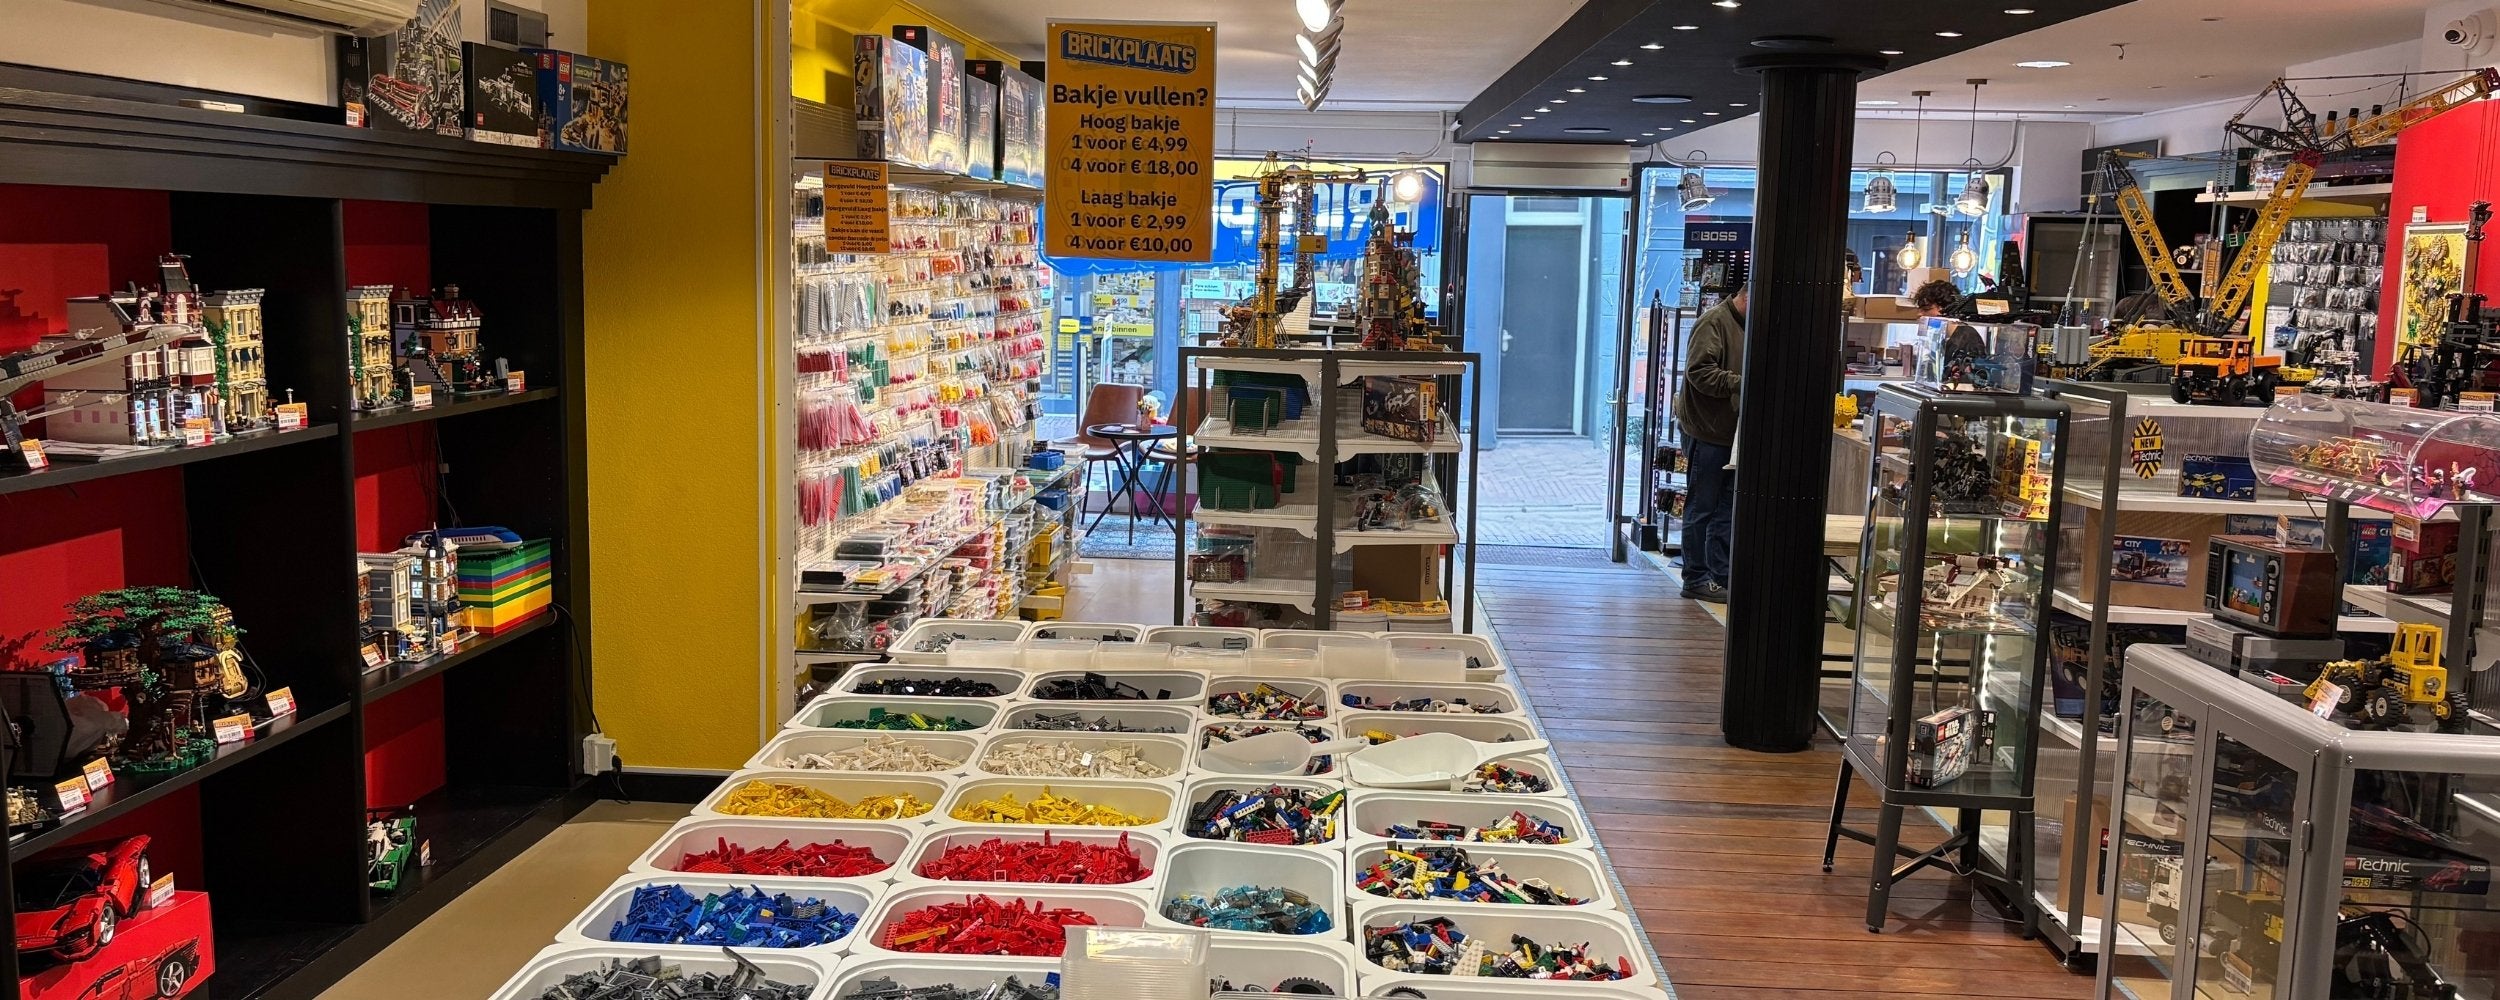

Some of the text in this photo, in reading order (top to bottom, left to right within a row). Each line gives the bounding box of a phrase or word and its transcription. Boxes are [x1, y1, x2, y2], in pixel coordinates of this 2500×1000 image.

[1067, 31, 1196, 70] BRICKPLAATS
[558, 84, 566, 95] 8+
[1053, 84, 1209, 108] Bakje vullen?
[1080, 114, 1180, 134] Hoog bakje
[1071, 134, 1188, 154] 1 voor € 4,99
[831, 165, 880, 180] BRICKPLAATS
[1070, 158, 1199, 178] 4 voor € 18,00
[1081, 190, 1177, 210] Laag bakje
[1071, 213, 1187, 232] 1 voor € 2,99
[1070, 235, 1193, 254] 4 voor €10,00
[1700, 231, 1738, 242] BOSS
[1111, 325, 1138, 333] binnen
[2140, 438, 2156, 449] NEW
[2139, 451, 2162, 462] Technic
[2183, 453, 2214, 462] Technic
[2361, 526, 2377, 536] LEGO
[2124, 540, 2142, 548] CITY
[2262, 812, 2288, 837] Technic
[2356, 857, 2411, 873] Technic
